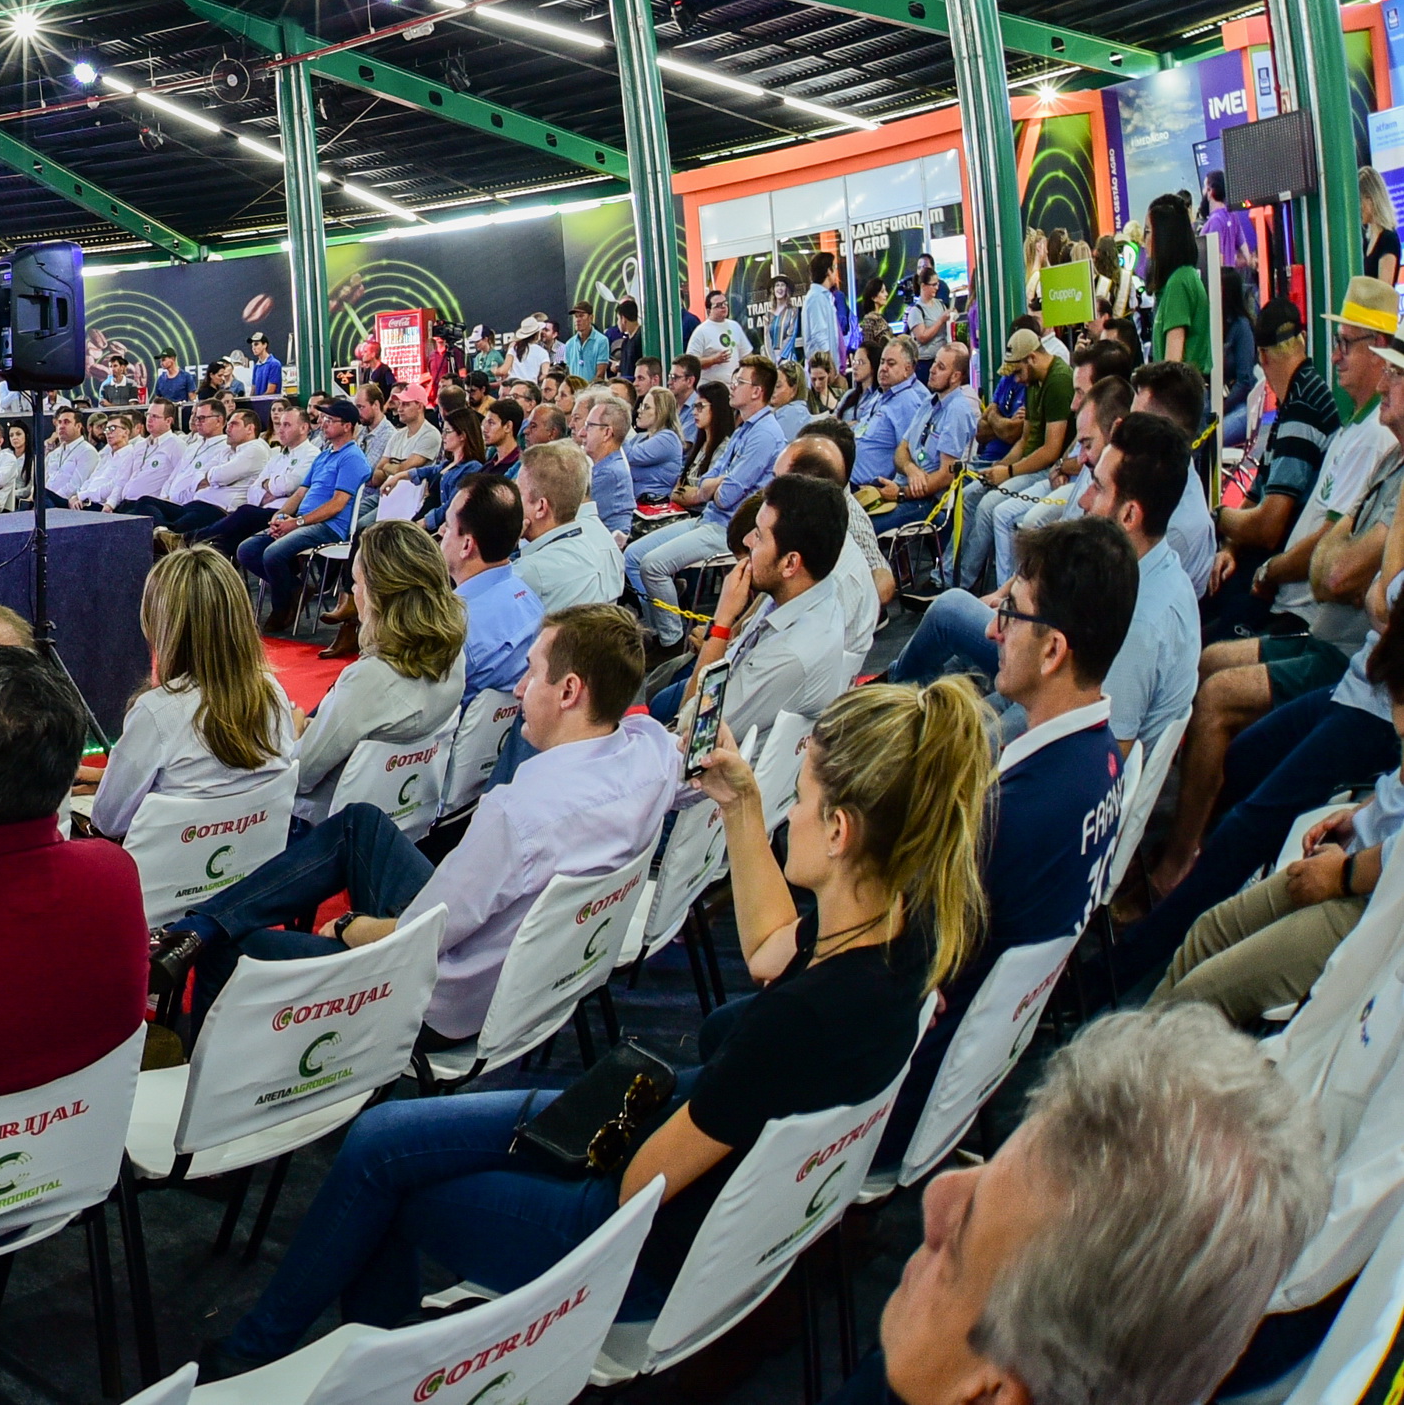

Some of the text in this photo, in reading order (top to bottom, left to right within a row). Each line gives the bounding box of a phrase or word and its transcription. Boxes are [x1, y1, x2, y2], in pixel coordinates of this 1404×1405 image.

[853, 234, 890, 254] AGRO
[180, 808, 269, 844] COTRIJAL
[272, 980, 393, 1032] COTRIJAL
[411, 1283, 592, 1404] COTRIJAL
